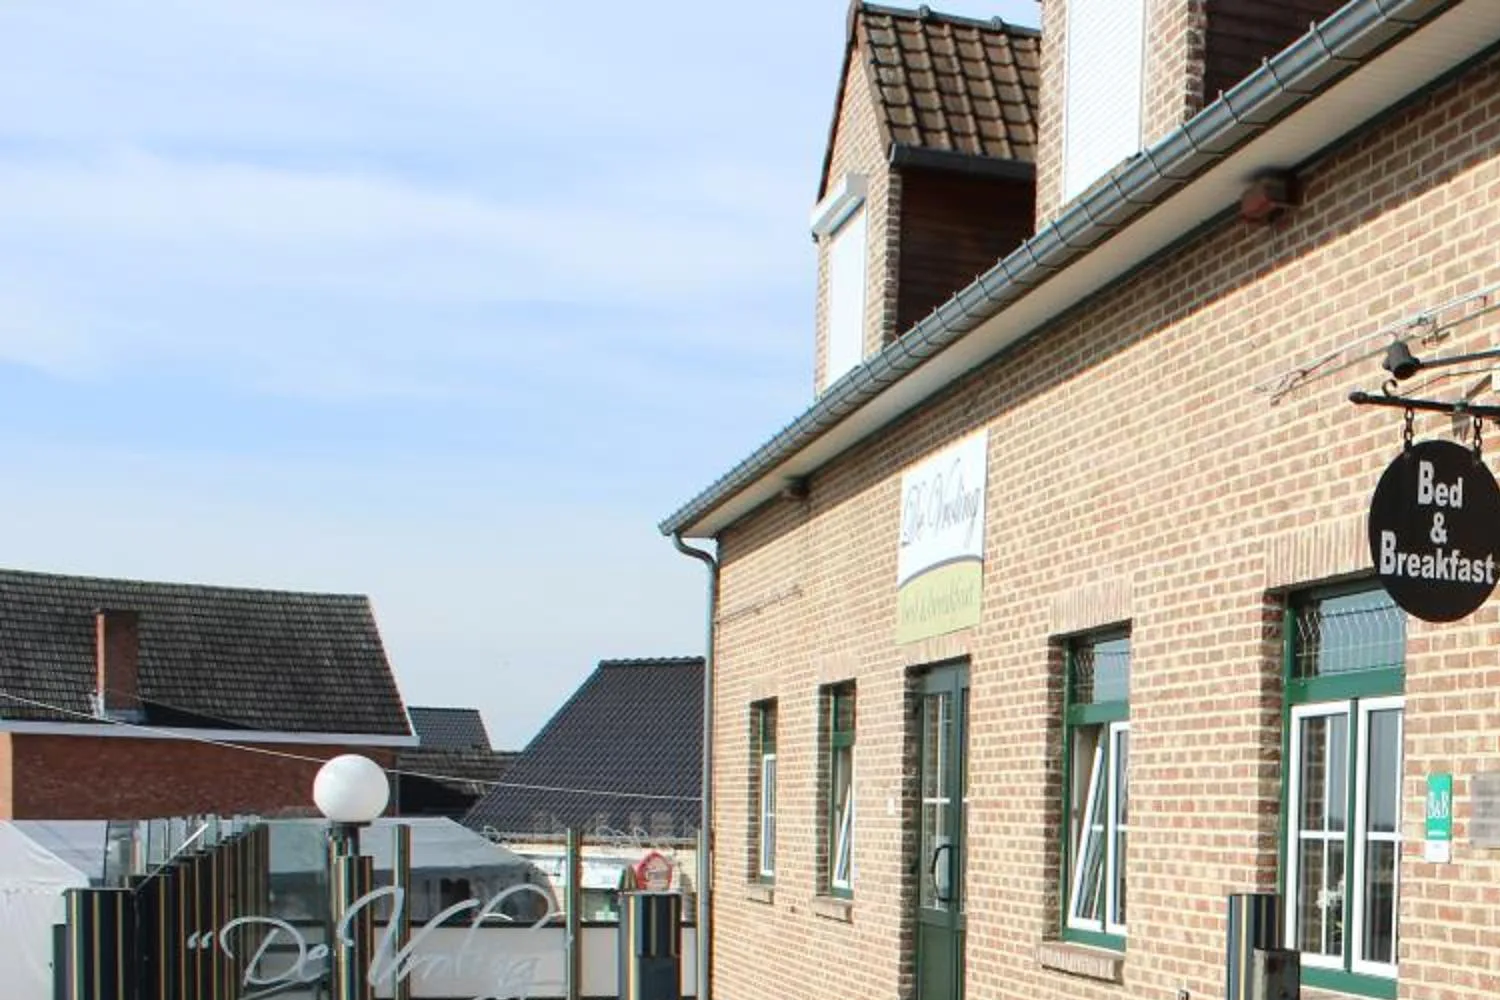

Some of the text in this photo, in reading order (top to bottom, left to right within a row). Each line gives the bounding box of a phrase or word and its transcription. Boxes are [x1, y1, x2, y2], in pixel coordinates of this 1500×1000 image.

[1418, 460, 1464, 509] Bed
[1430, 511, 1448, 544] &
[1379, 530, 1494, 585] Breakfast
